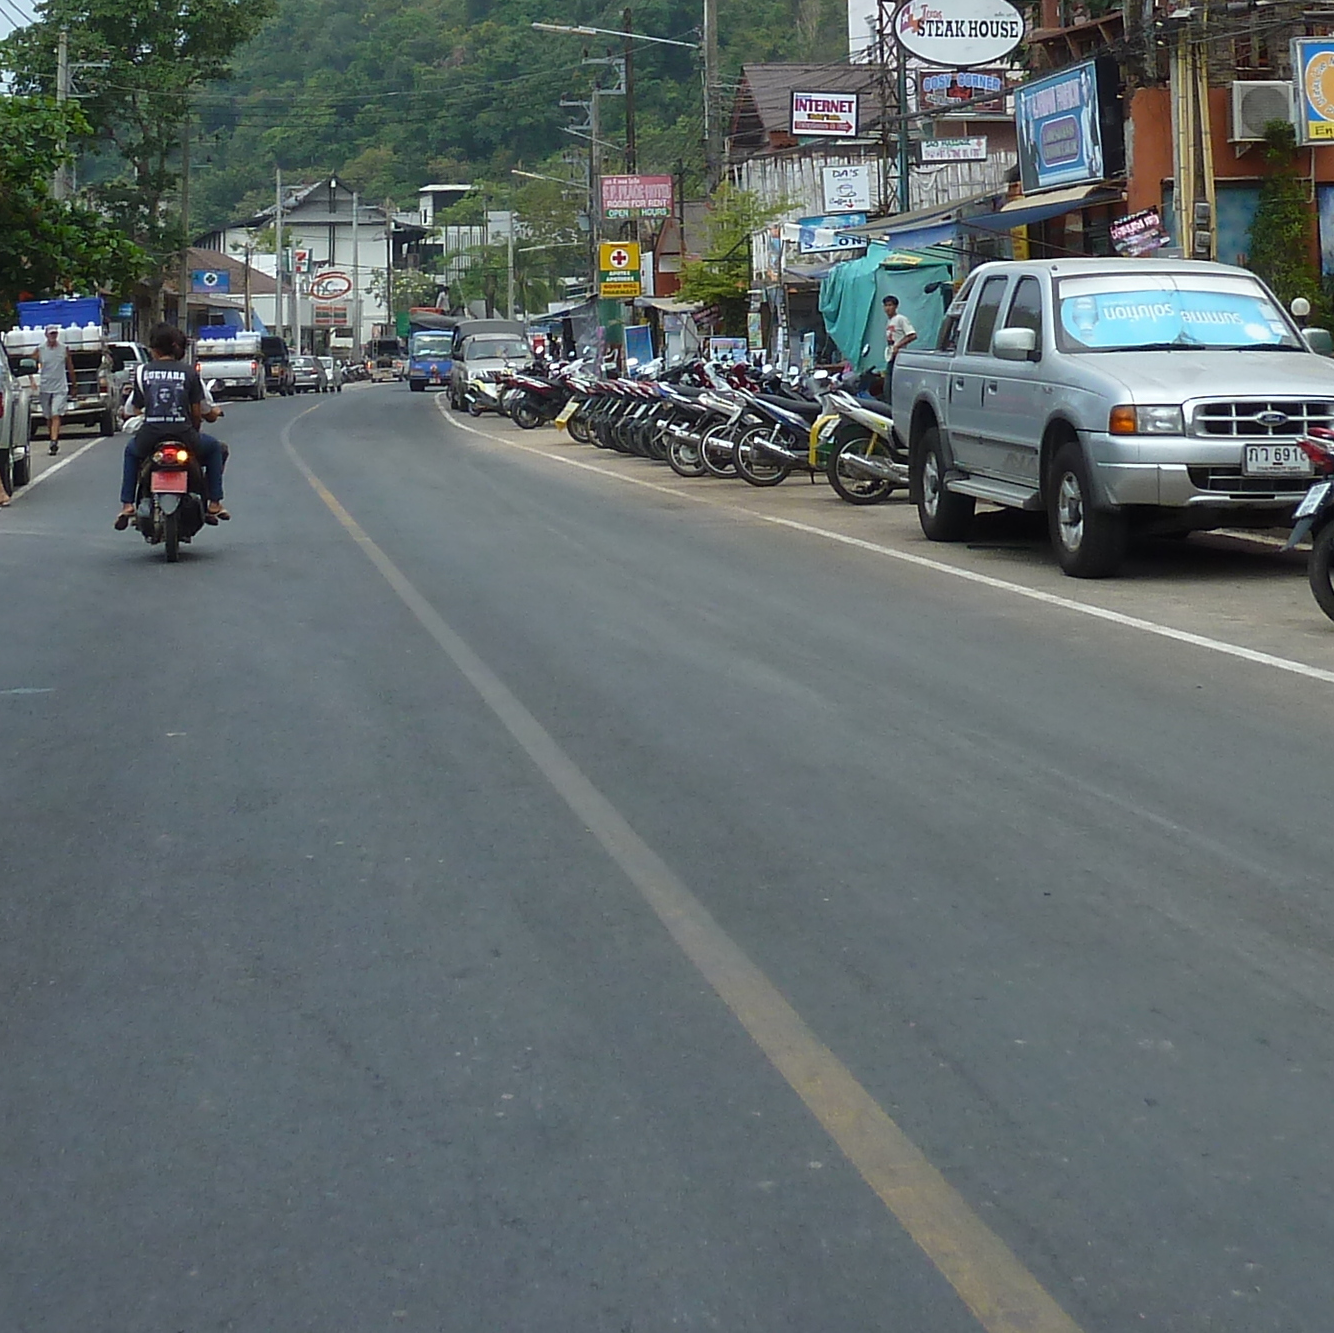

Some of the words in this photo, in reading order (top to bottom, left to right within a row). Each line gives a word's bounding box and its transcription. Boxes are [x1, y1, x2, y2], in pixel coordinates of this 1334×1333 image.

[917, 20, 966, 37] STEAK
[968, 21, 1018, 37] HOUSE
[795, 98, 855, 113] INTERNET
[607, 200, 630, 208] ROOM
[631, 200, 646, 208] FOR
[648, 199, 667, 208] RENT
[608, 209, 629, 217] OPEN
[641, 208, 667, 216] HOURS
[1103, 303, 1175, 323] solution
[1182, 310, 1244, 326] summe
